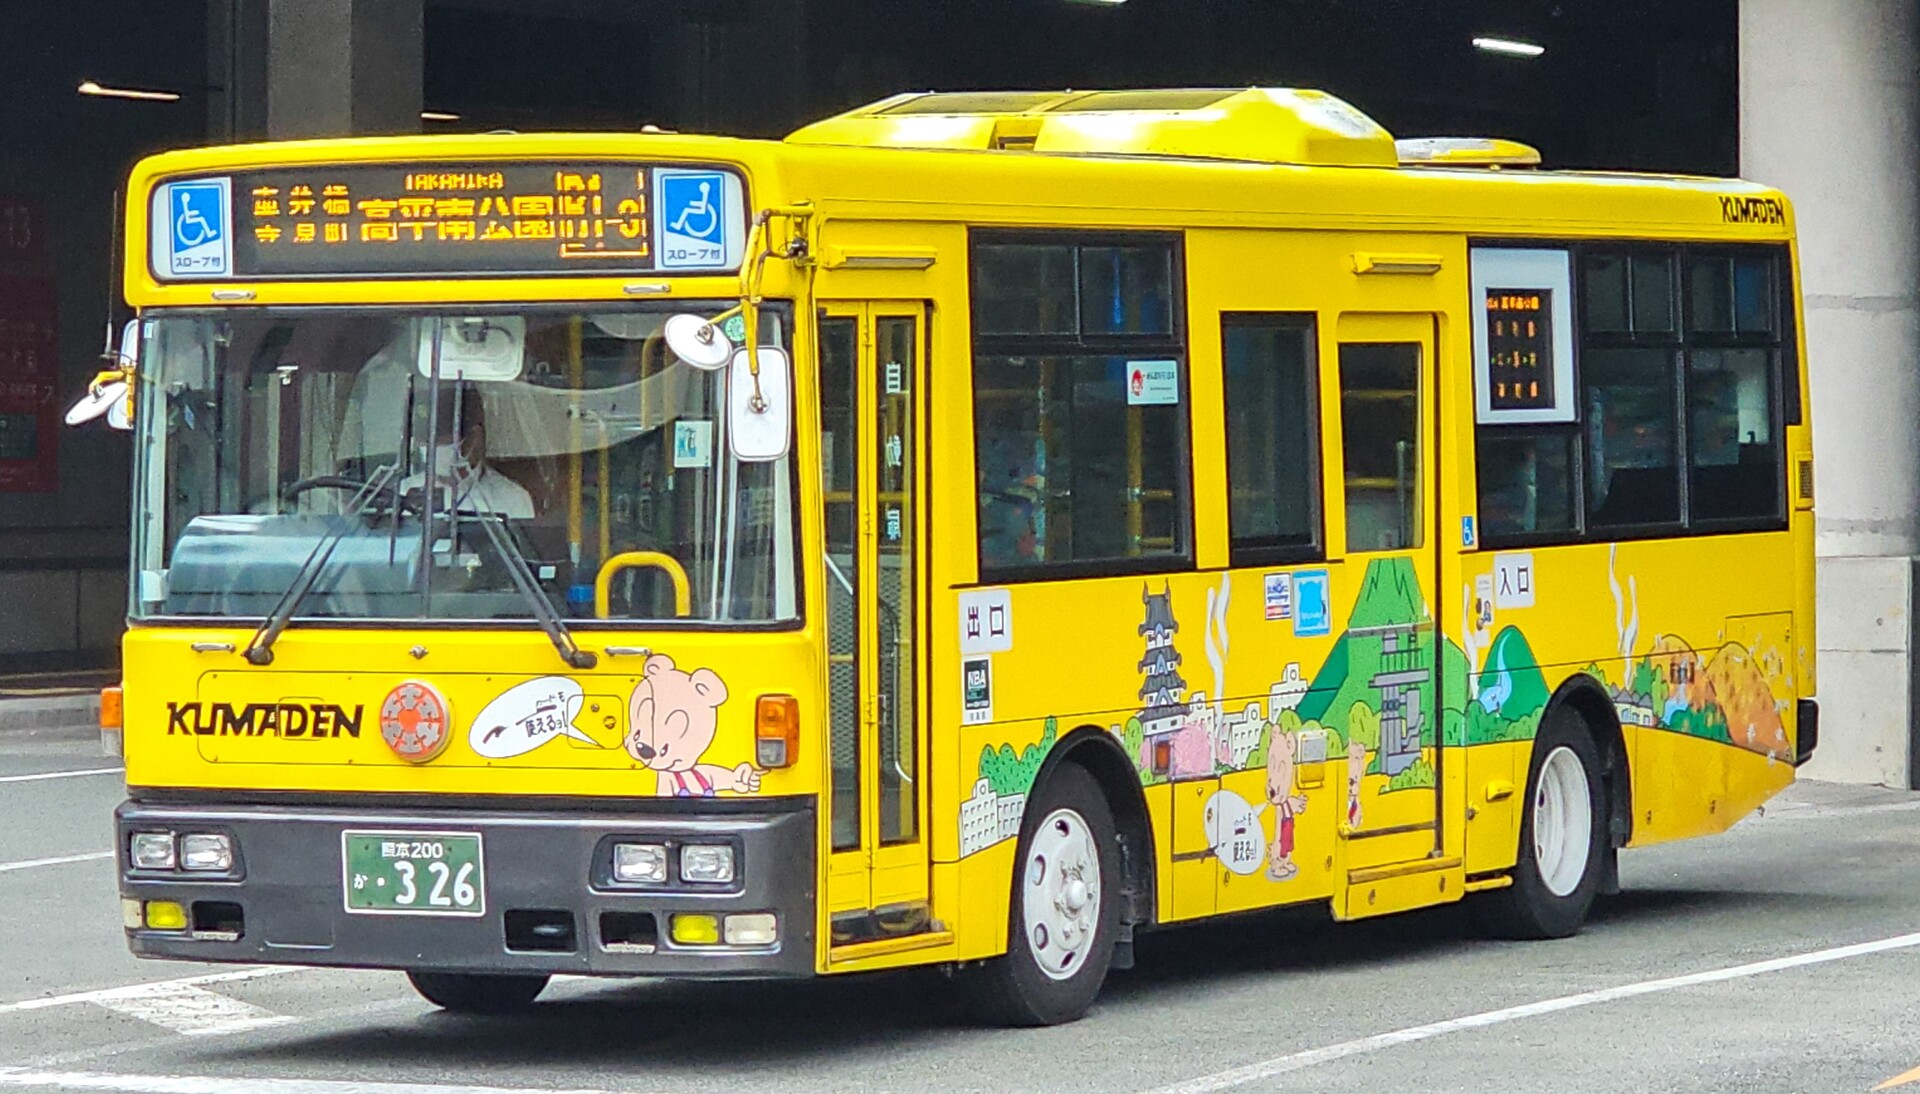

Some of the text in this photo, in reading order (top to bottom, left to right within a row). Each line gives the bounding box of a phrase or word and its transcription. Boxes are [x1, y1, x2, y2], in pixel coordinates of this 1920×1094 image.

[1719, 195, 1786, 227] KUMADEN
[1499, 565, 1529, 596] 入口
[967, 604, 1005, 640] 出口
[166, 701, 365, 739] KUMADEN
